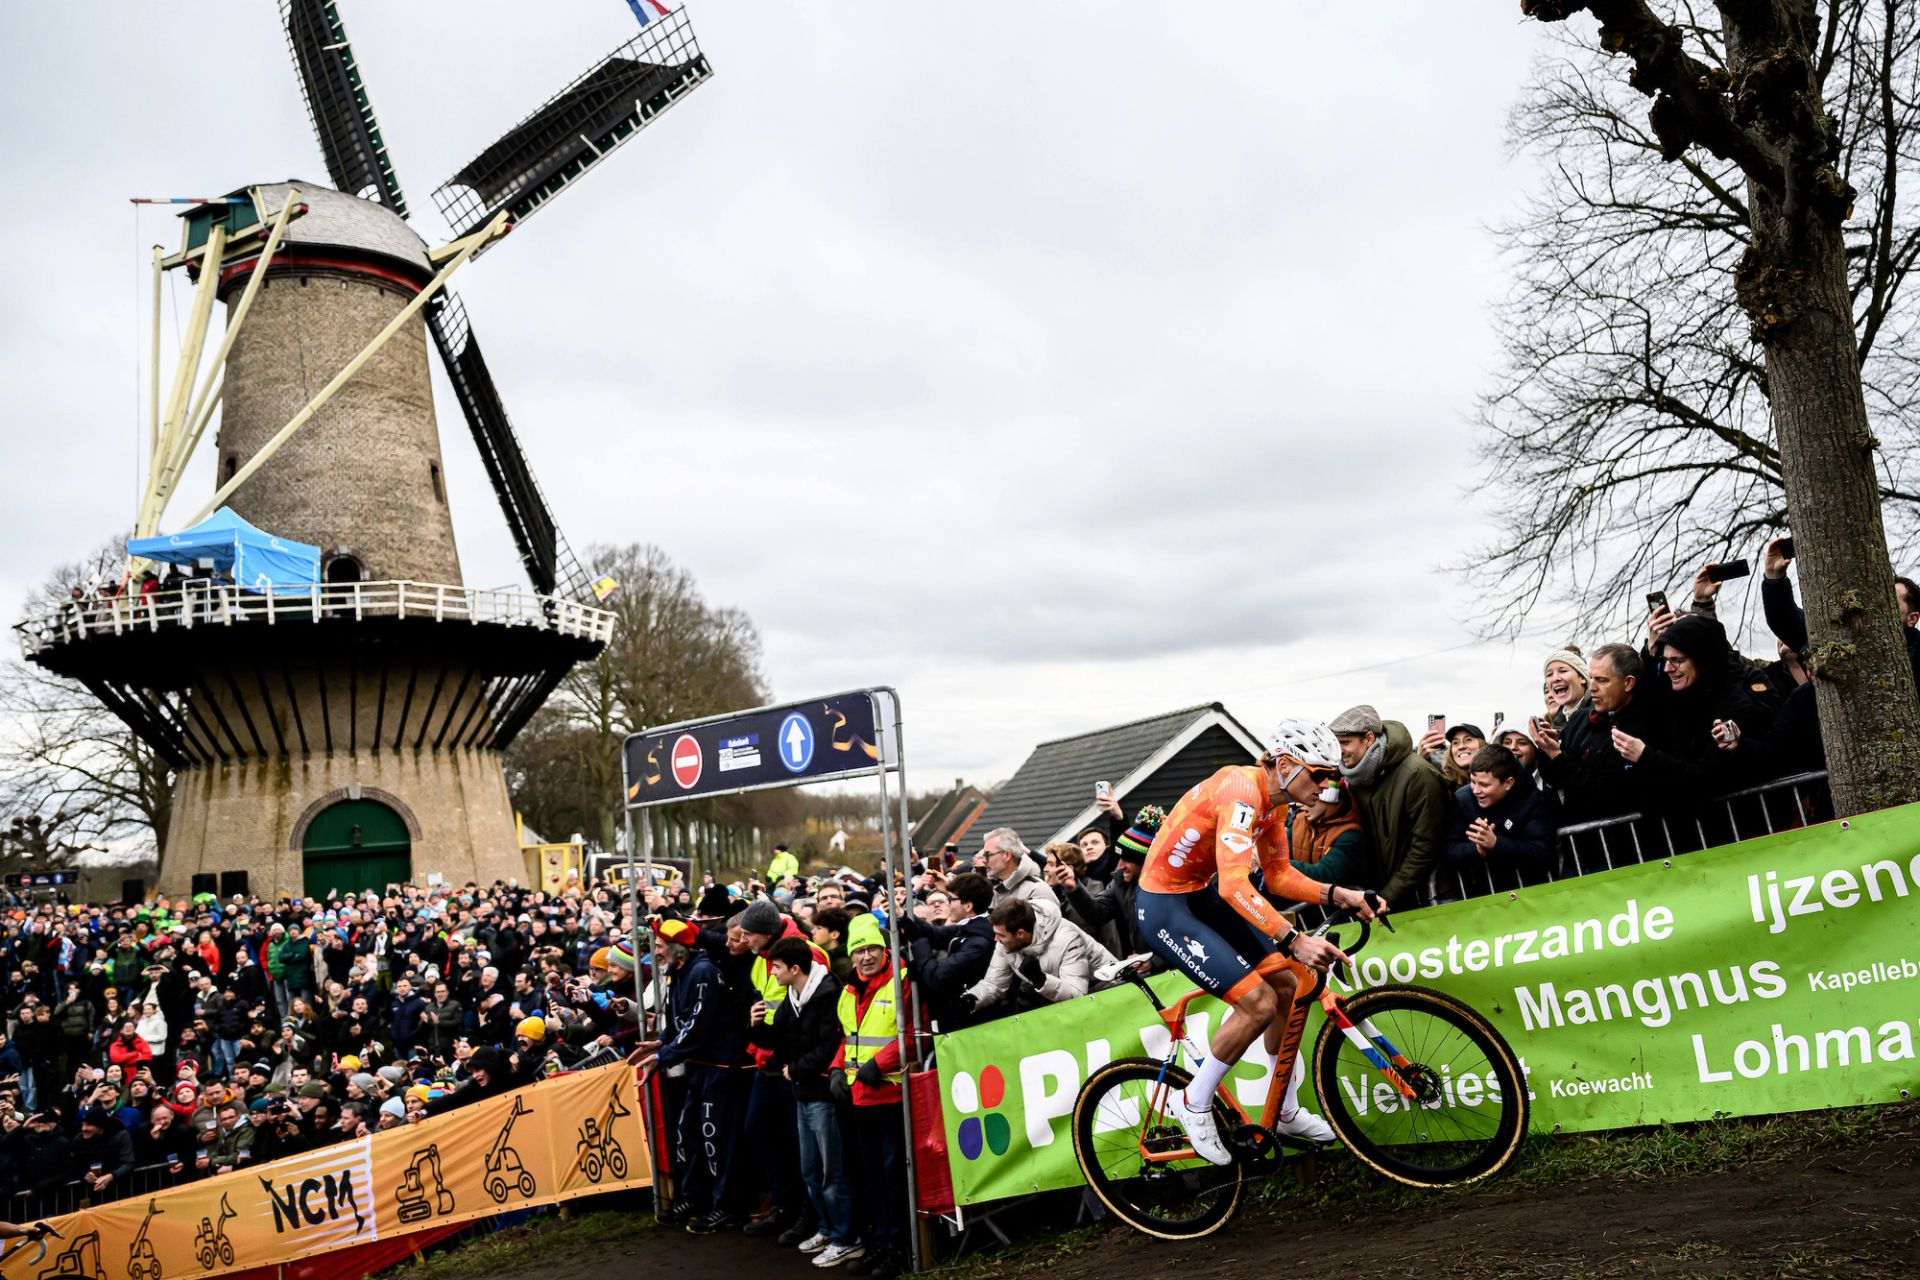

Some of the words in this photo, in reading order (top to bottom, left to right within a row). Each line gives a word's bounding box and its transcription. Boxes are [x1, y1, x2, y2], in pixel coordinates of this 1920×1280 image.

[1240, 811, 1247, 824] 1
[1233, 891, 1268, 925] Staatsloterij
[1747, 853, 1920, 934] Ijzen
[1157, 928, 1220, 989] Staatsloterij
[1514, 960, 1787, 1029] Mangnus
[1808, 958, 1920, 993] Kapelleb
[1691, 1019, 1920, 1084] Lohma
[1550, 1071, 1653, 1098] Koewacht
[258, 1169, 365, 1235] NCM
